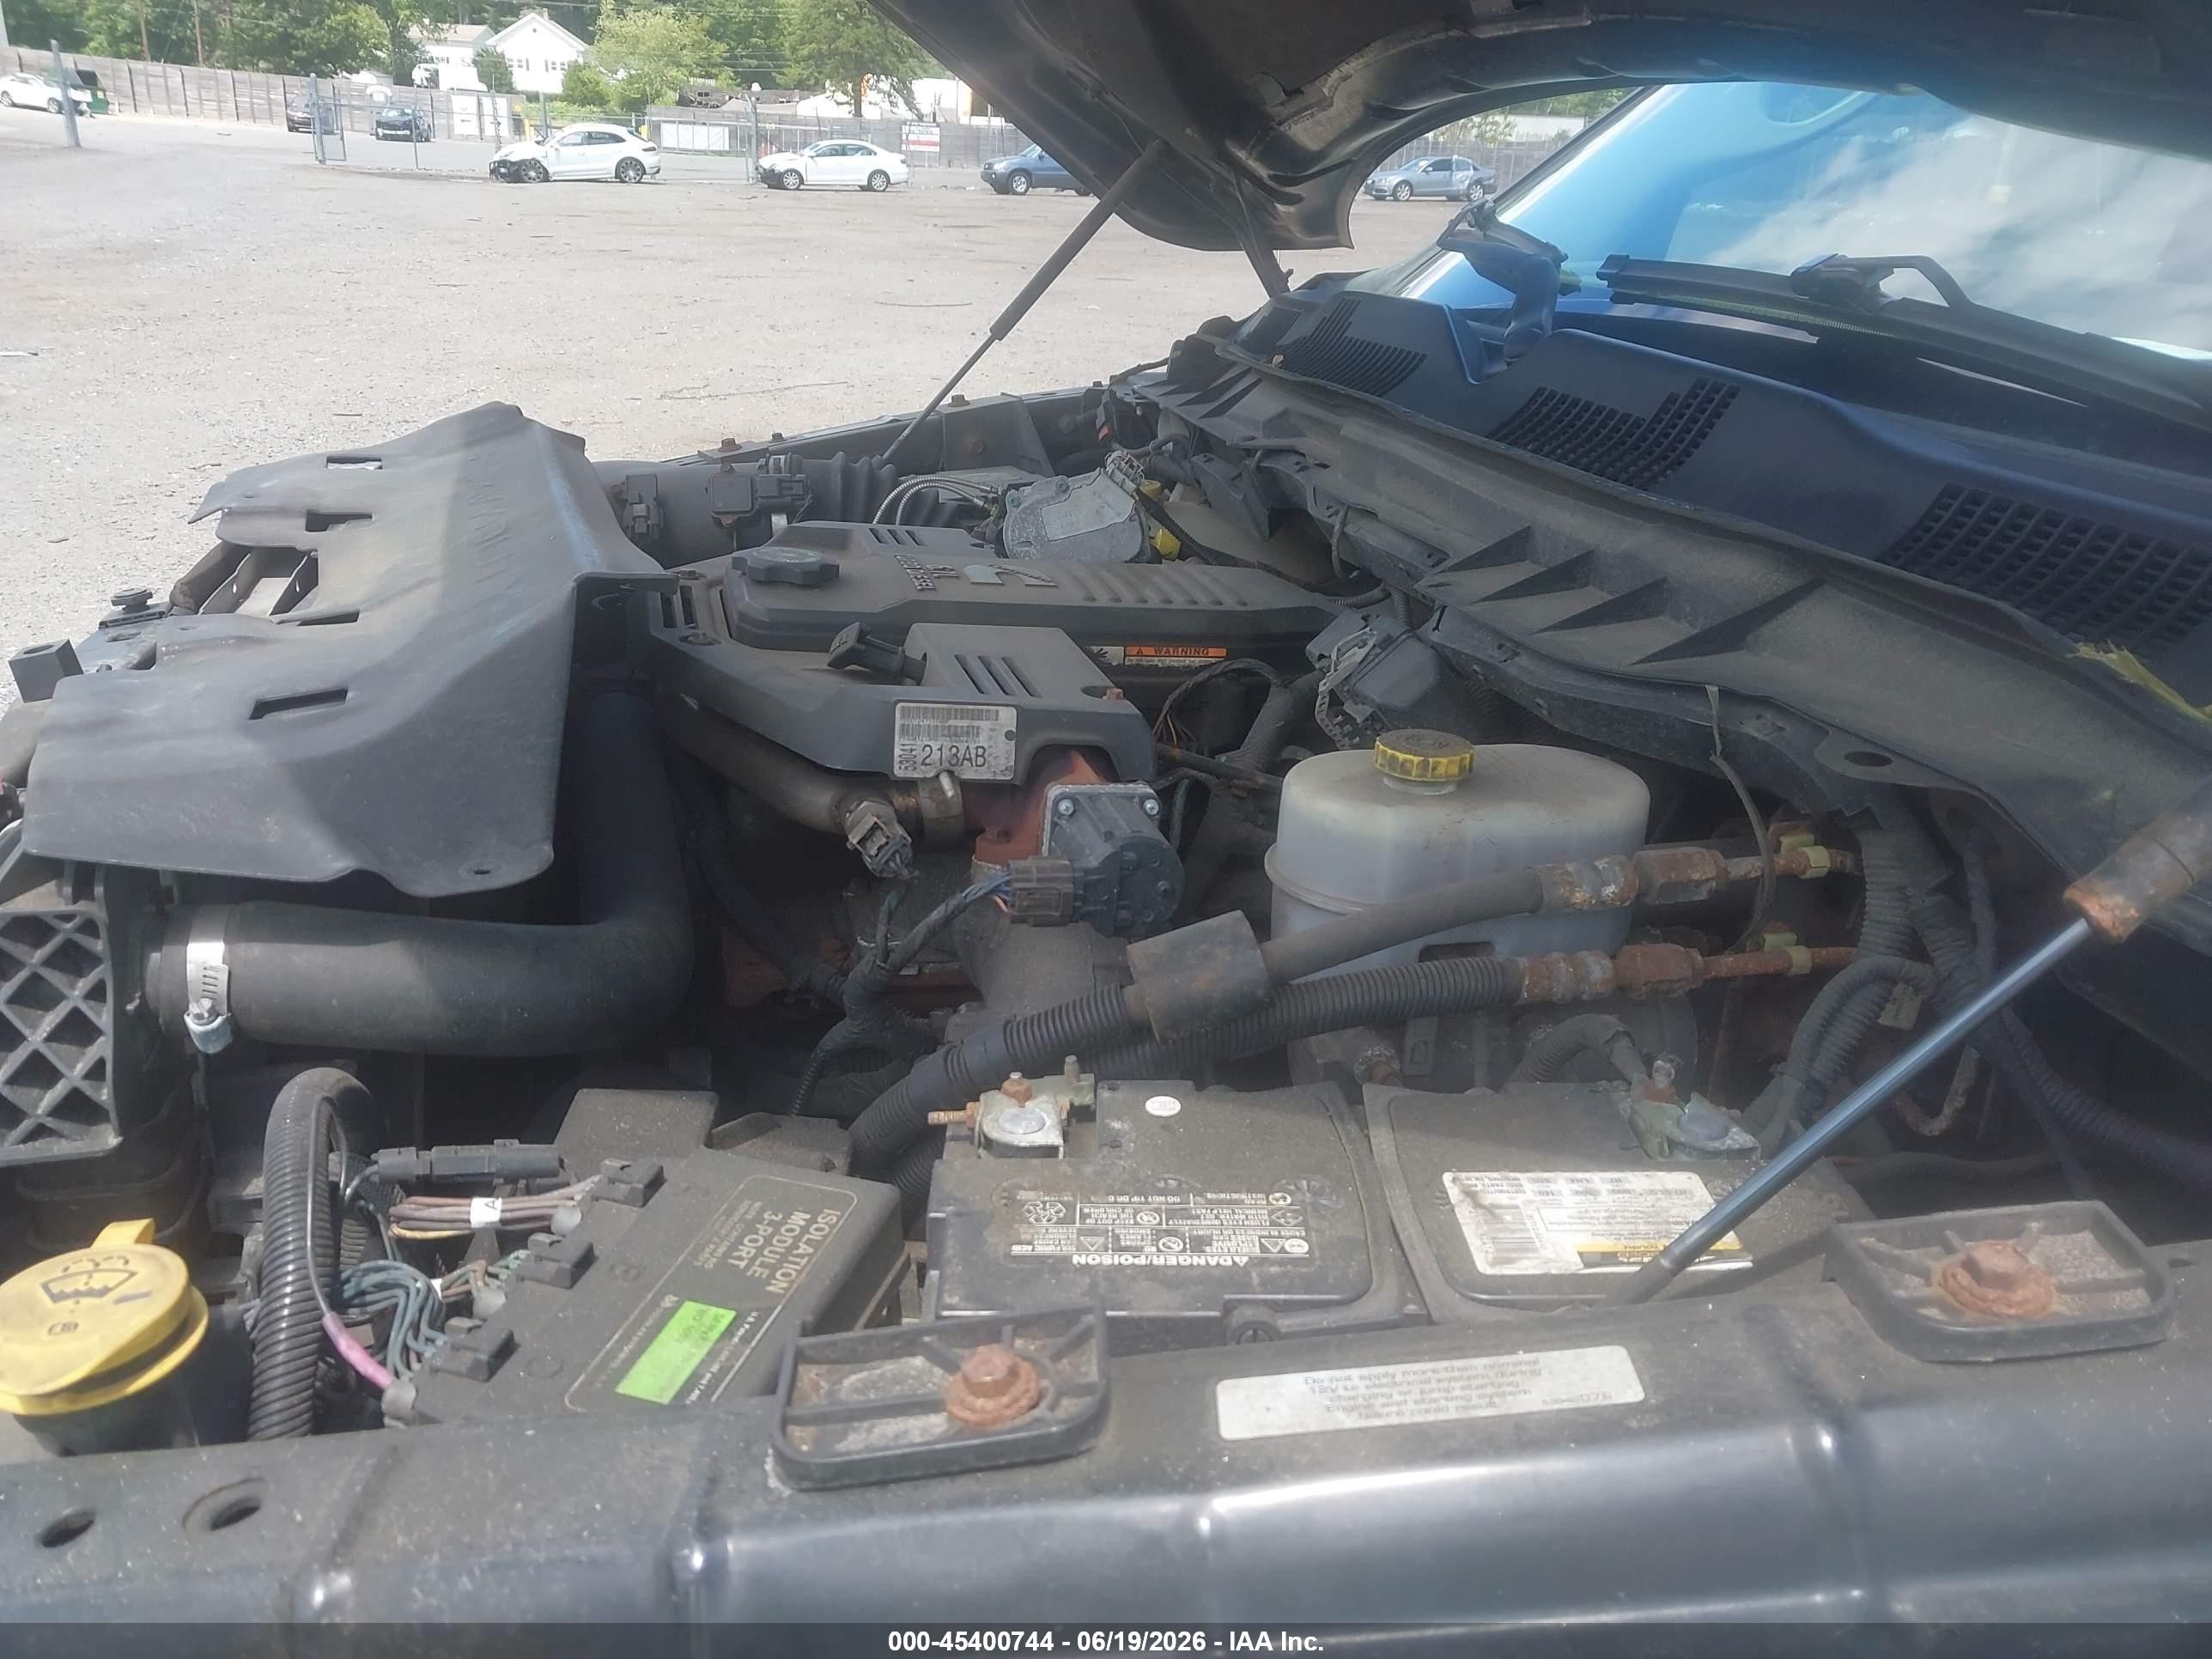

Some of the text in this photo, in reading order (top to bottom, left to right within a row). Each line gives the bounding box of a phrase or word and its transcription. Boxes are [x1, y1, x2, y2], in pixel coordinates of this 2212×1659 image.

[1153, 647, 1210, 656] WARNING
[898, 742, 920, 771] 53041
[921, 744, 987, 768] 213AB
[484, 1199, 498, 1210] A
[727, 1210, 783, 1270] 3-PORT
[745, 1210, 811, 1279] MODULE
[765, 1207, 842, 1294] ISOLATION
[1072, 1254, 1232, 1266] DANGER/POISON
[1304, 1376, 1325, 1385] Do
[1329, 1373, 1352, 1383] not
[1358, 1372, 1396, 1383] apply
[1401, 1368, 1438, 1378] more
[1311, 1385, 1339, 1395] 12V
[1343, 1383, 1359, 1392] to
[1364, 1376, 1431, 1390] electrical
[1436, 1371, 1491, 1384] system
[1329, 1390, 1393, 1403] charging
[1381, 1398, 1408, 1408] and
[1477, 1388, 1533, 1401] system
